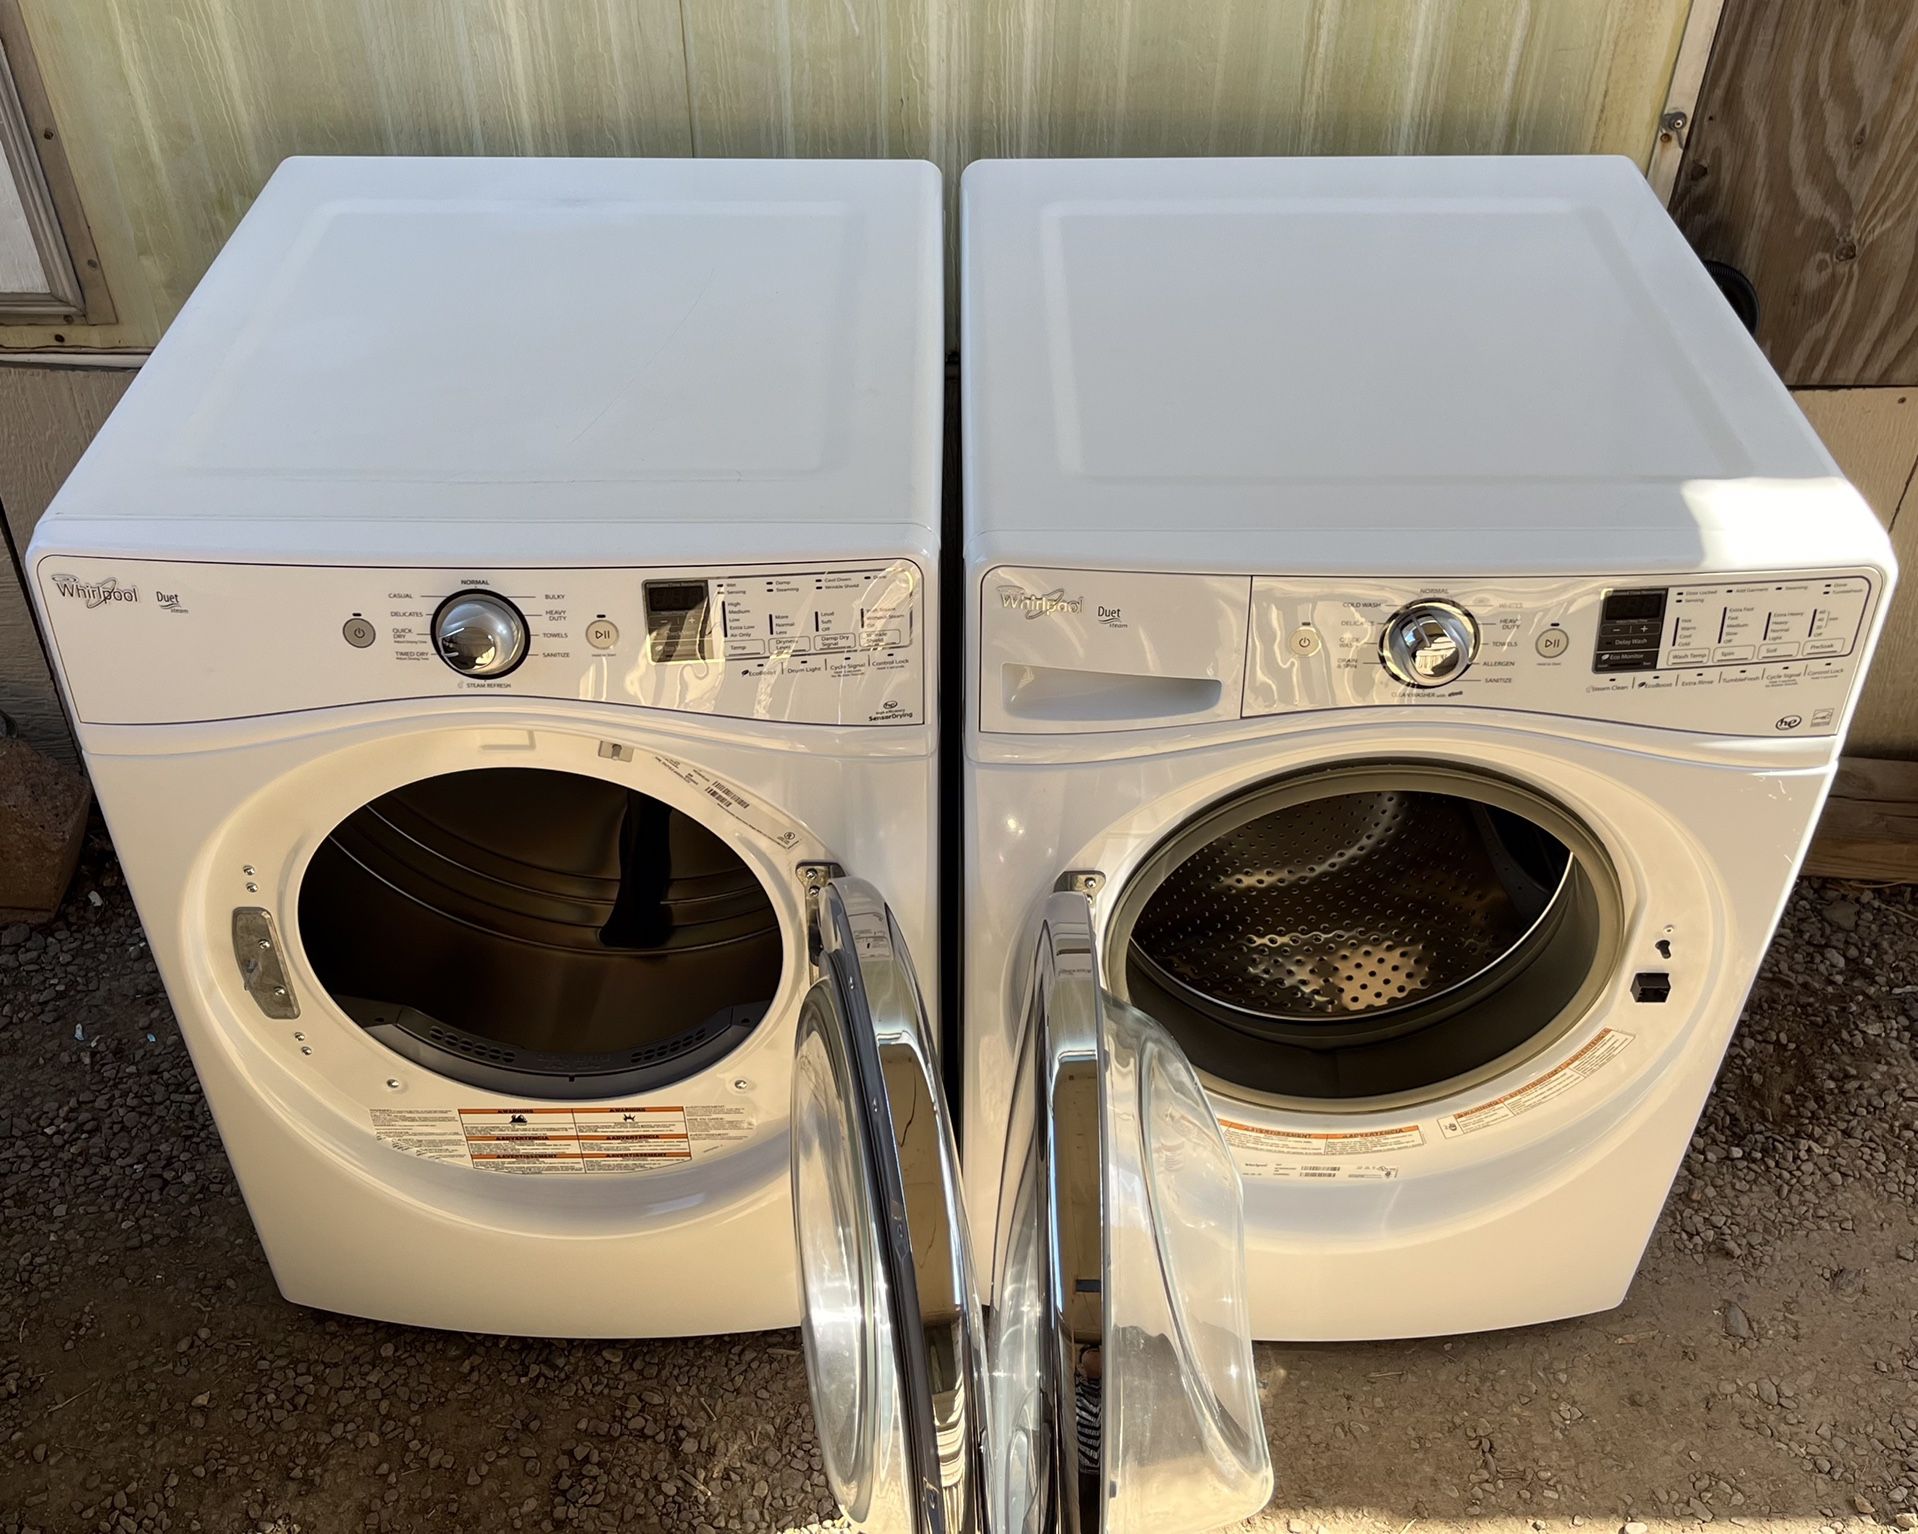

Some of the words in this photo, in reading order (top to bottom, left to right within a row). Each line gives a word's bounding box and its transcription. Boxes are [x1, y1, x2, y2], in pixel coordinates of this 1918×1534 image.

[56, 582, 139, 605] Whirlpool
[156, 591, 179, 604] Duet
[1097, 606, 1121, 618] Duet
[868, 711, 913, 722] SensorDrying
